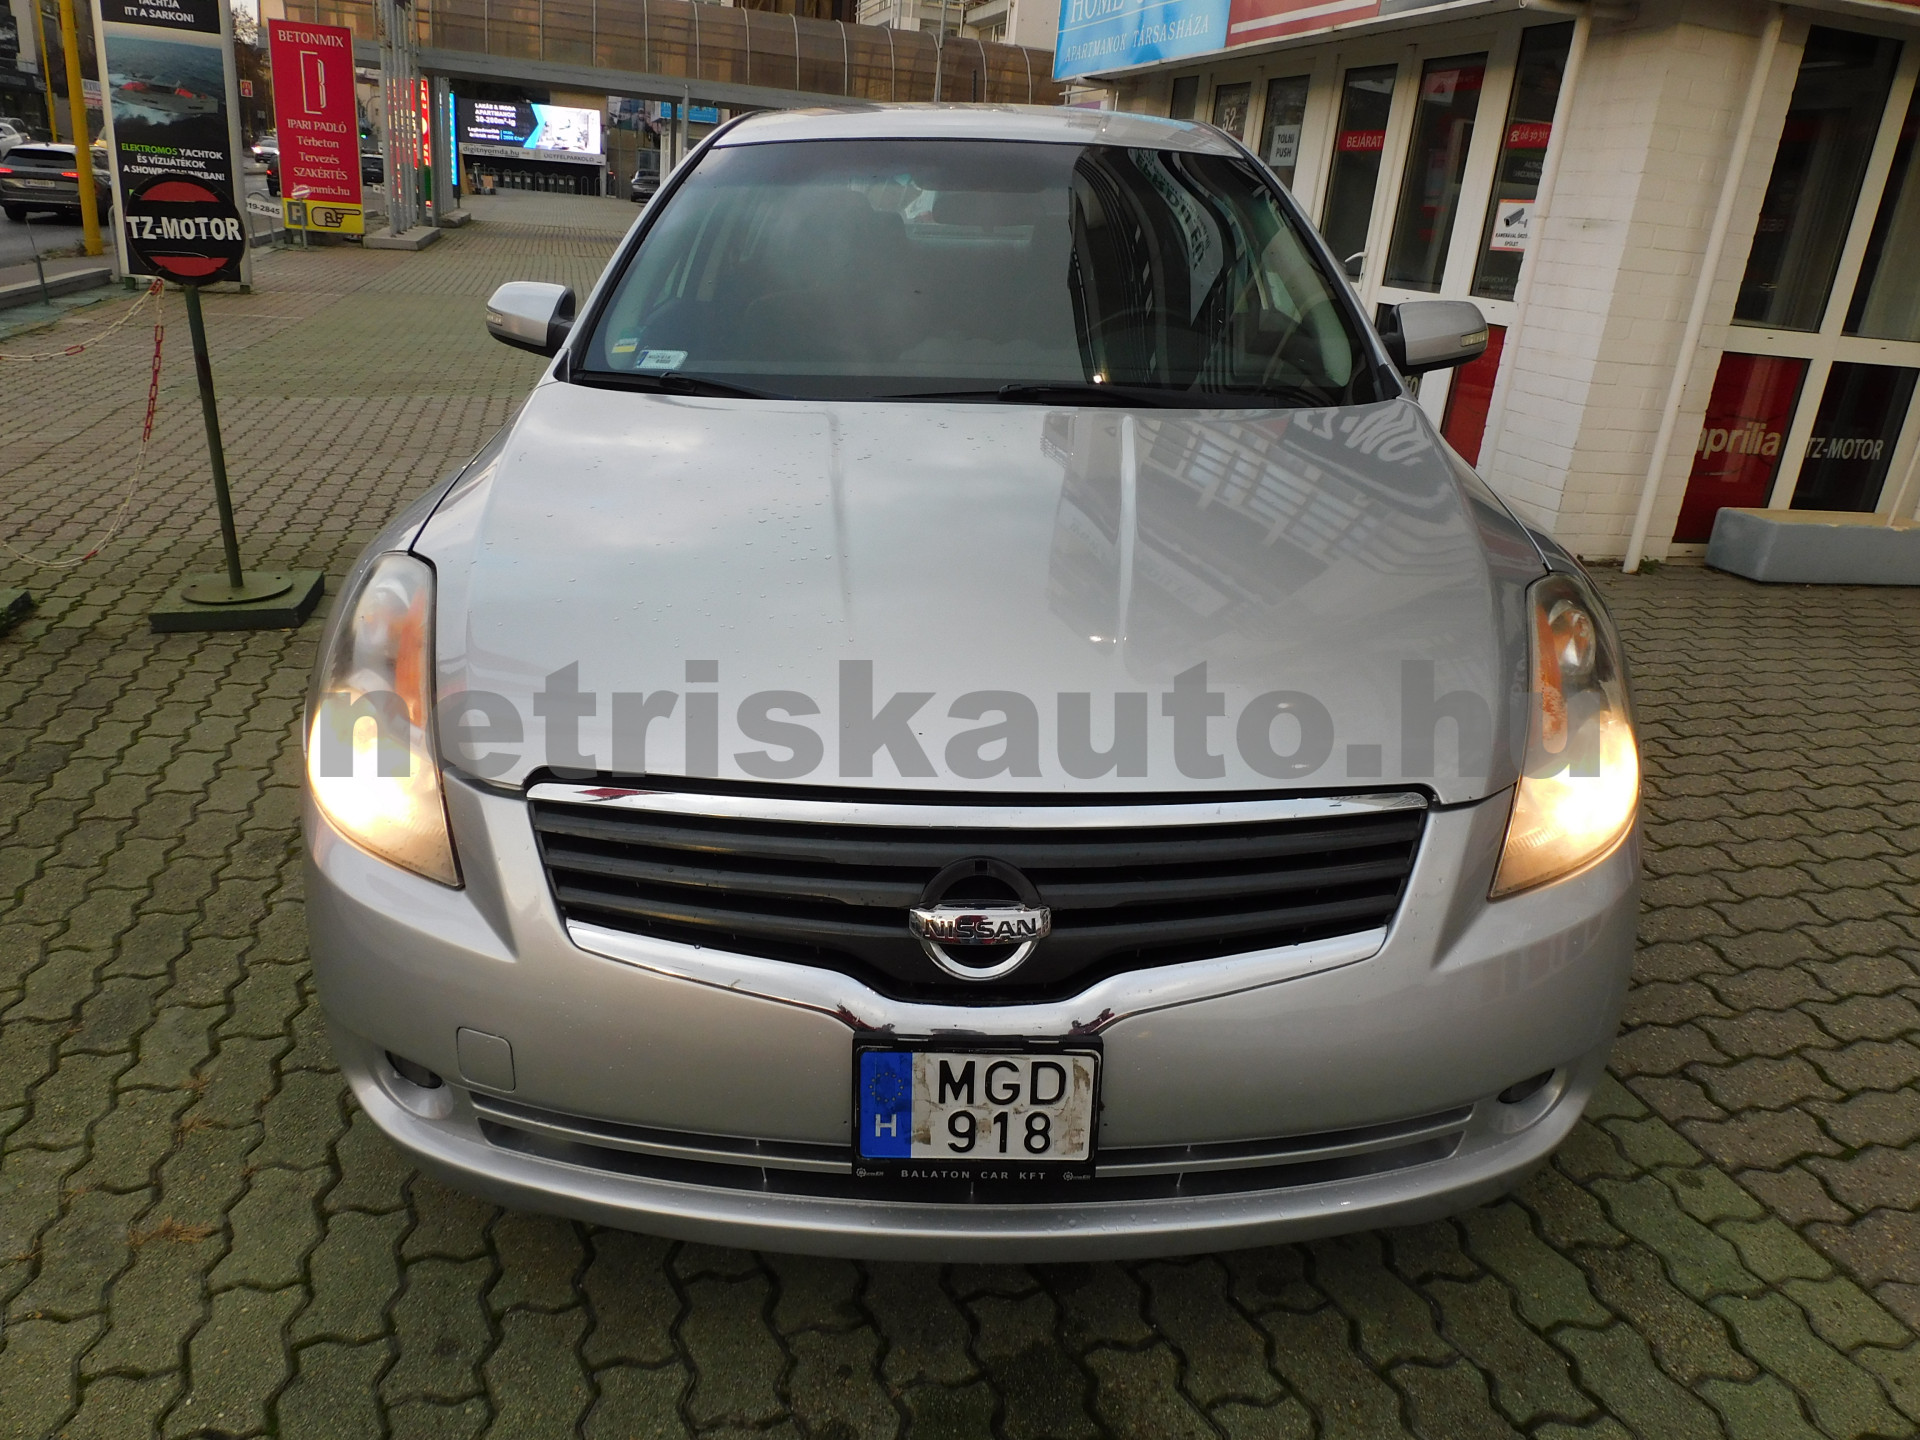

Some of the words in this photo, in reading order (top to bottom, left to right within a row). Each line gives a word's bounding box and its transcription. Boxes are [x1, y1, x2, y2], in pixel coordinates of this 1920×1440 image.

[124, 6, 138, 16] ITT
[140, 9, 148, 17] A
[149, 9, 195, 23] SARKON!
[277, 29, 344, 48] BETONMIX
[1065, 32, 1127, 62] APARTMANOK
[1133, 14, 1209, 48] TÁRSASHÁZA
[287, 118, 312, 130] IPARI
[314, 121, 347, 133] PADLÓ
[296, 135, 340, 149] Térbeton
[1346, 134, 1383, 148] BEJÁRAT
[121, 142, 178, 155] ELEKTROMOS
[179, 148, 223, 160] YACHTOK
[136, 153, 148, 164] ÉS
[298, 151, 340, 165] Tervezés
[123, 165, 131, 173] A
[293, 166, 348, 180] SZAKÉRTÉS
[293, 182, 351, 196] bonmix.hu
[125, 215, 242, 241] TZ-MOTOR
[1805, 437, 1884, 461] TZ-MOTOR
[923, 918, 1037, 939] NISSAN
[938, 1060, 1067, 1106] MGD
[875, 1113, 897, 1138] H
[948, 1110, 1051, 1154] 918
[900, 1169, 970, 1179] BALATON
[980, 1171, 1008, 1180] CAR
[1019, 1172, 1046, 1181] KFT
